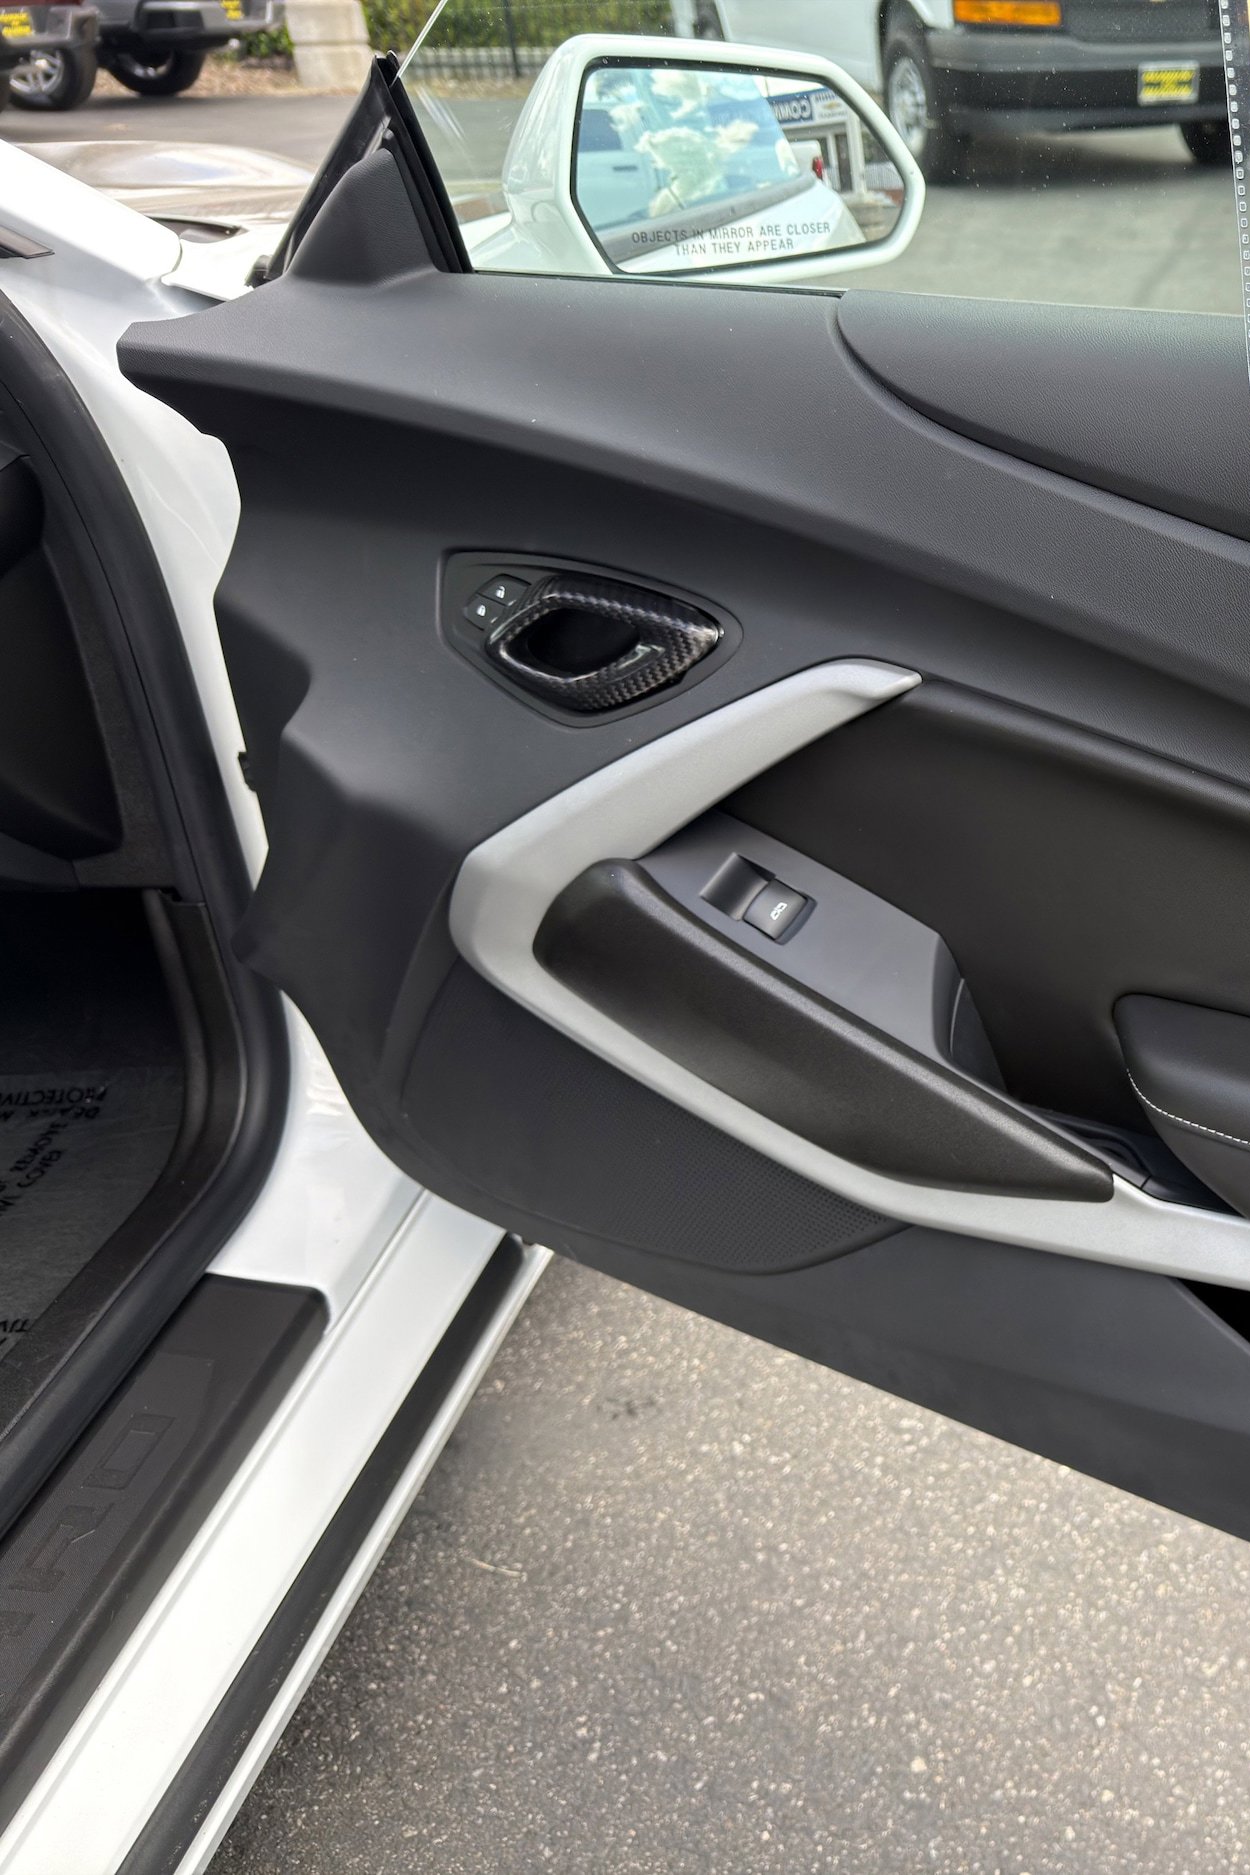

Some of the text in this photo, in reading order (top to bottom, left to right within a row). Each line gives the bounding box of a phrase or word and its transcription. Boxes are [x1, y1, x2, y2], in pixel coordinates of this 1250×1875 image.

[632, 222, 830, 244] OBJECTS IN MIRROR ARE CLOSER
[676, 238, 794, 256] THAN THEY APPEAR
